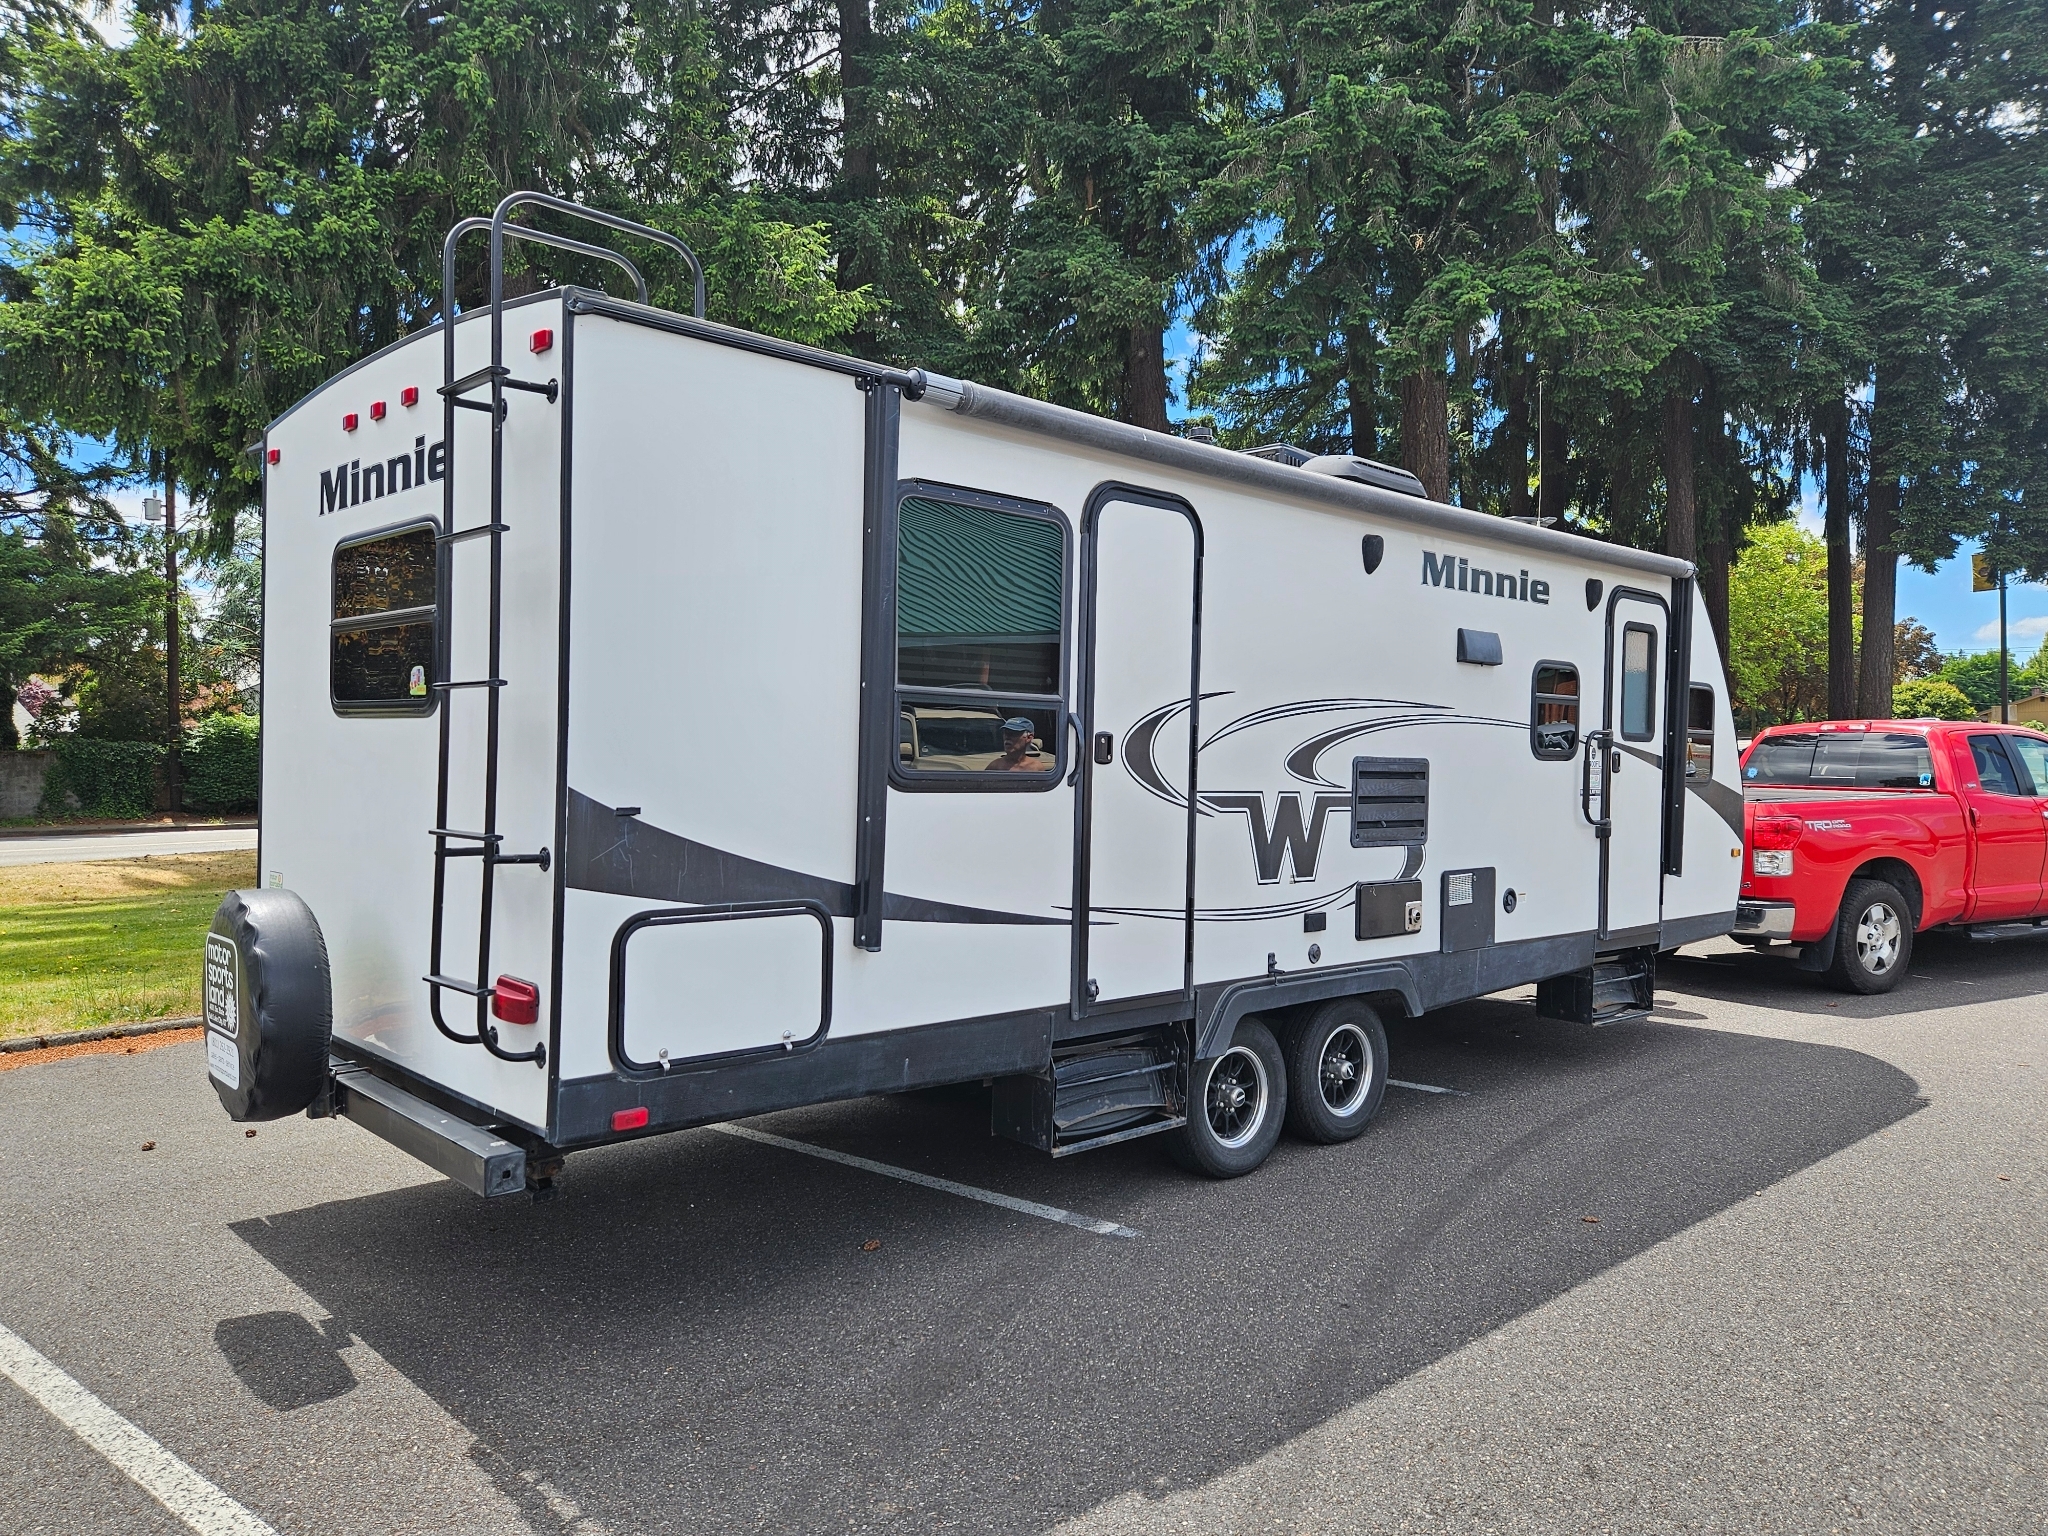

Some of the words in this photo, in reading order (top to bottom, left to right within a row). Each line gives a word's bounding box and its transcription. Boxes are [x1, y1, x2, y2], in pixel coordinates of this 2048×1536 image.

[319, 434, 445, 517] Minnie
[1421, 549, 1550, 606] Minnie
[1804, 820, 1832, 832] TRD
[208, 943, 231, 966] motor
[208, 962, 234, 990] sports
[208, 980, 225, 1008] land
